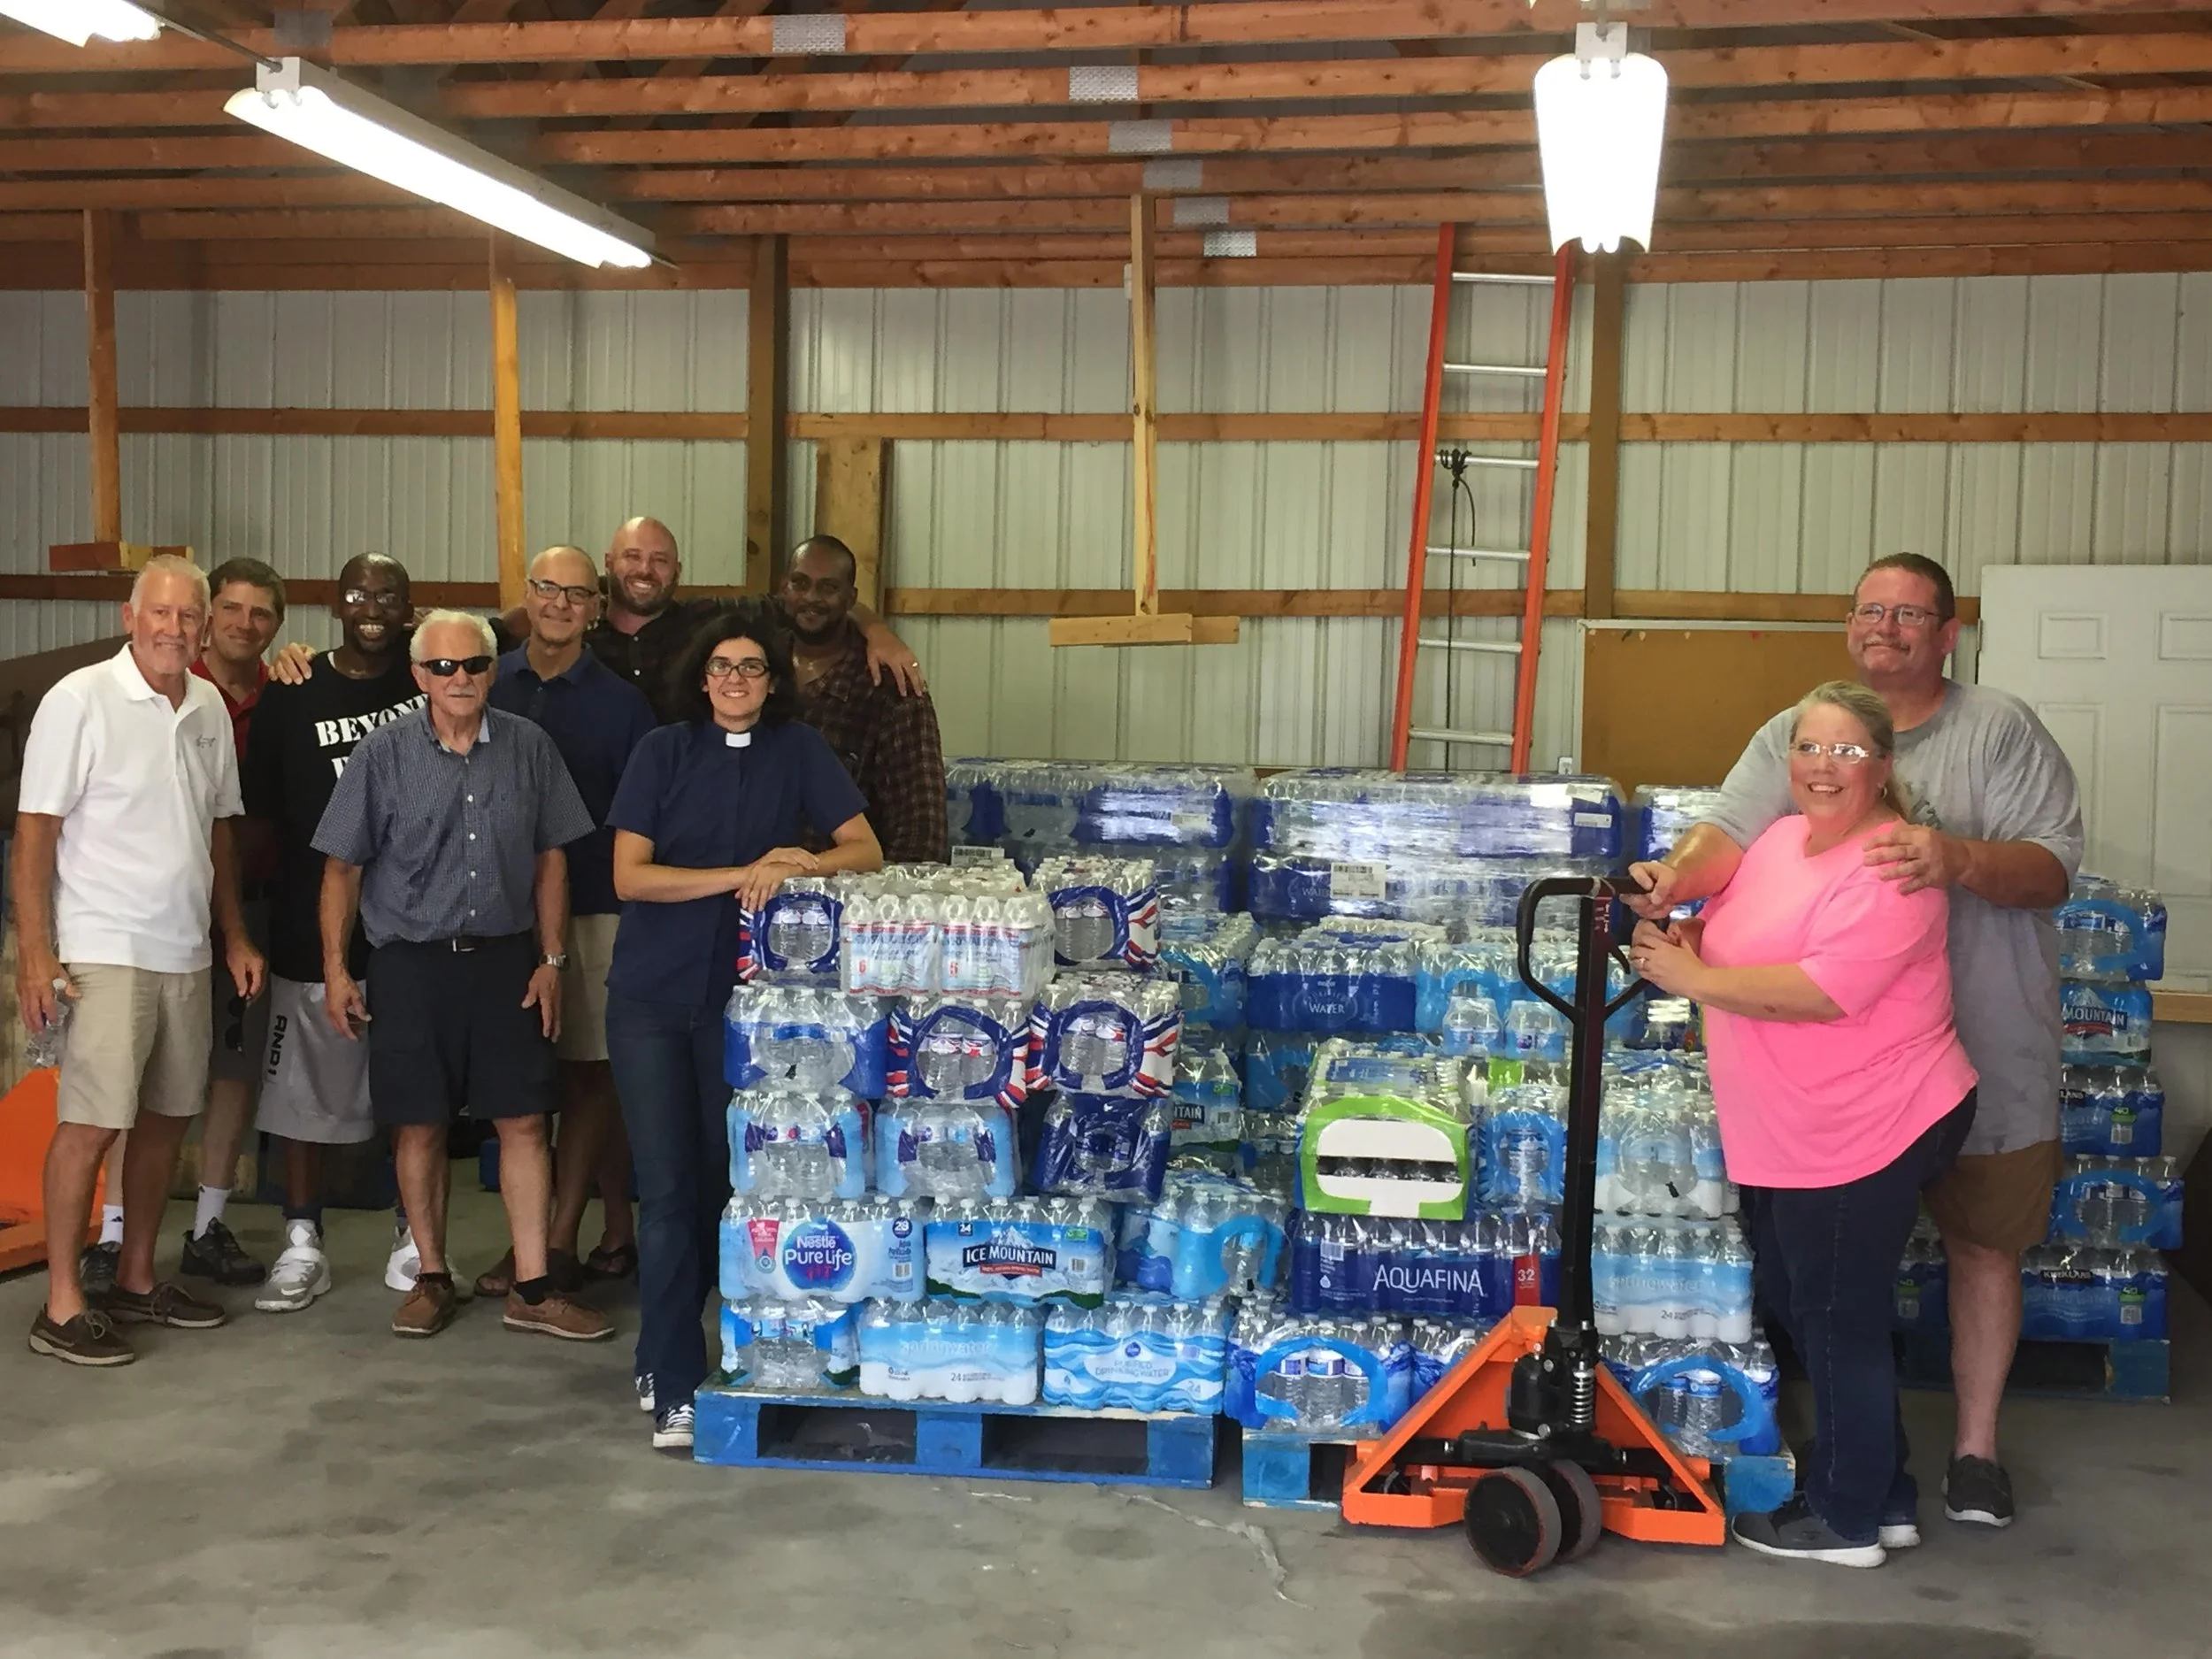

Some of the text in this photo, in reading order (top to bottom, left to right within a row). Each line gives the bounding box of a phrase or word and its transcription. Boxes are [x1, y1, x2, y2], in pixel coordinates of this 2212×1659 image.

[1310, 1003, 1345, 1014] WATER
[786, 1249, 852, 1271] Pure Life
[966, 1245, 1054, 1265] ICE MOUNTAIN
[1373, 1263, 1486, 1297] AQUAFINA
[1517, 1270, 1535, 1281] 32
[1662, 1310, 1673, 1319] 24
[951, 1372, 962, 1381] 24
[1188, 1380, 1201, 1394] 24
